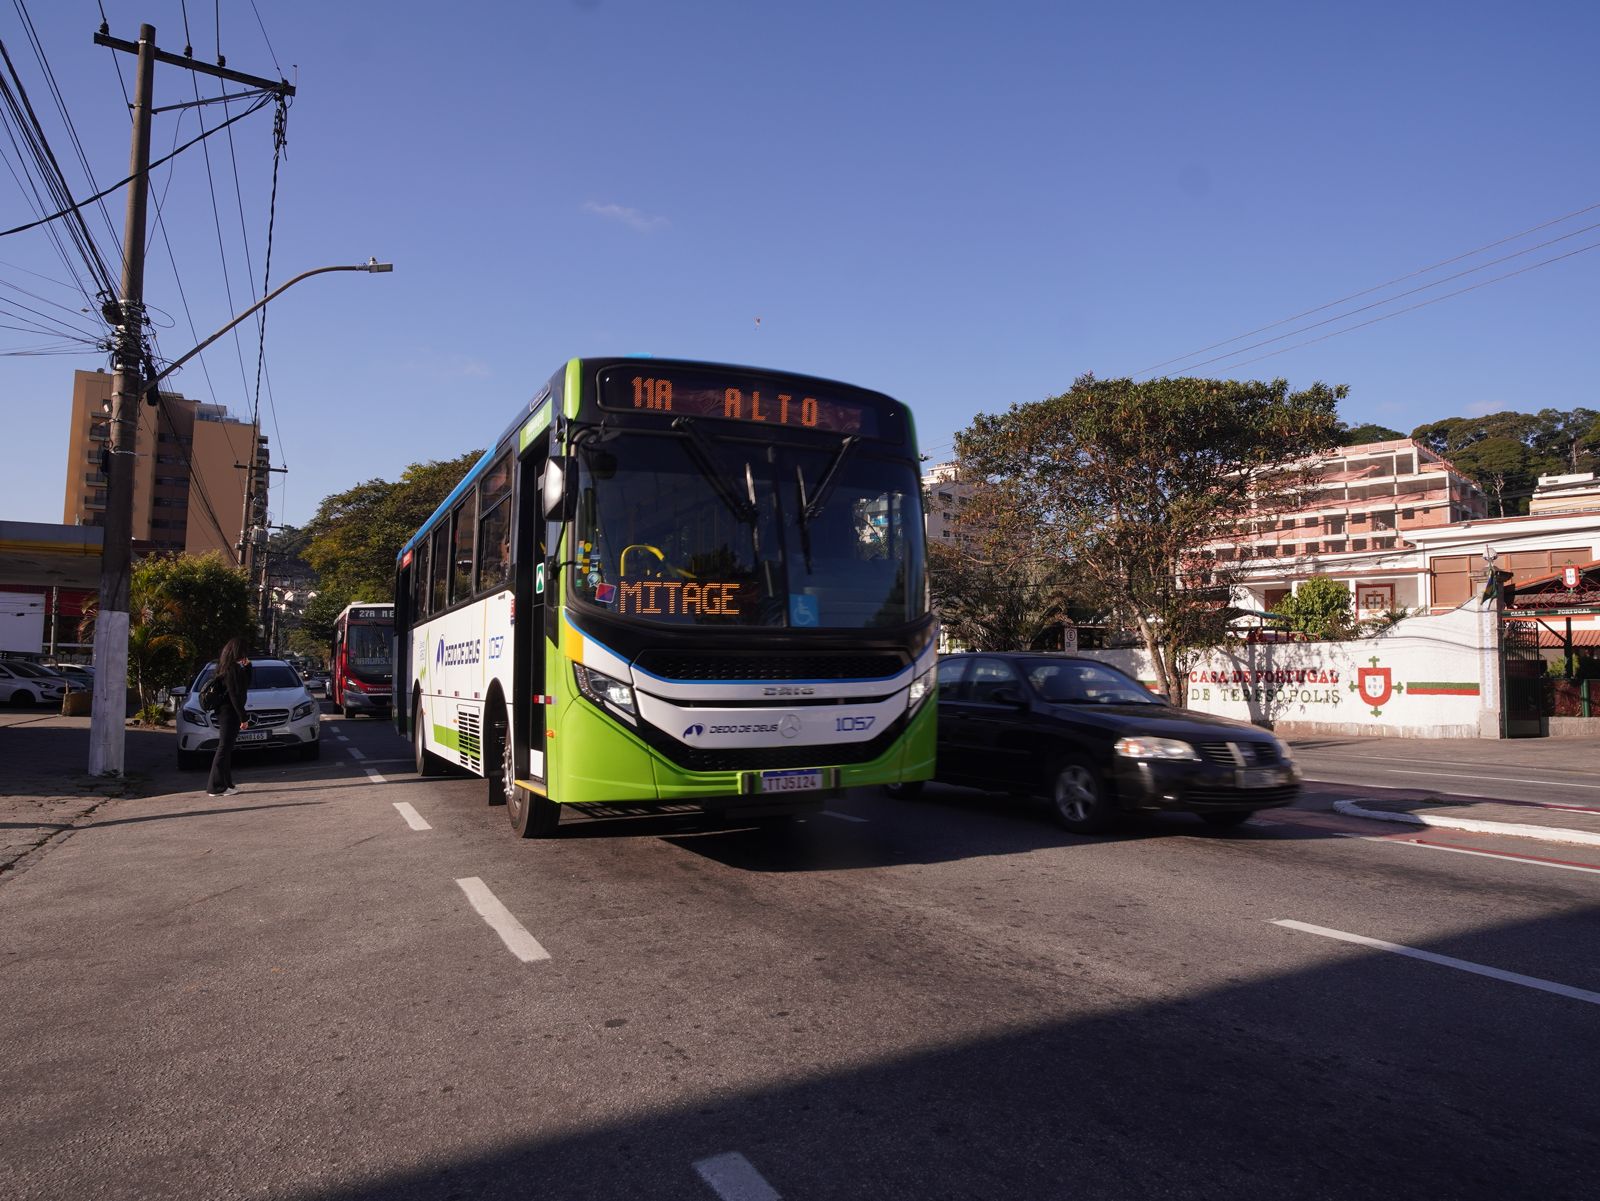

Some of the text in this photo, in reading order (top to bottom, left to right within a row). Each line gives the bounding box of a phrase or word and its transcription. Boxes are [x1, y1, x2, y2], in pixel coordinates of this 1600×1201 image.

[632, 376, 818, 427] 11A ALTO
[619, 581, 741, 615] MITAGE
[359, 610, 375, 618] 27A
[1190, 669, 1340, 684] CASA DE PORTUGAL
[1191, 688, 1211, 701] DE
[709, 724, 778, 734] DEDO DE DEUS
[836, 716, 876, 731] 1057
